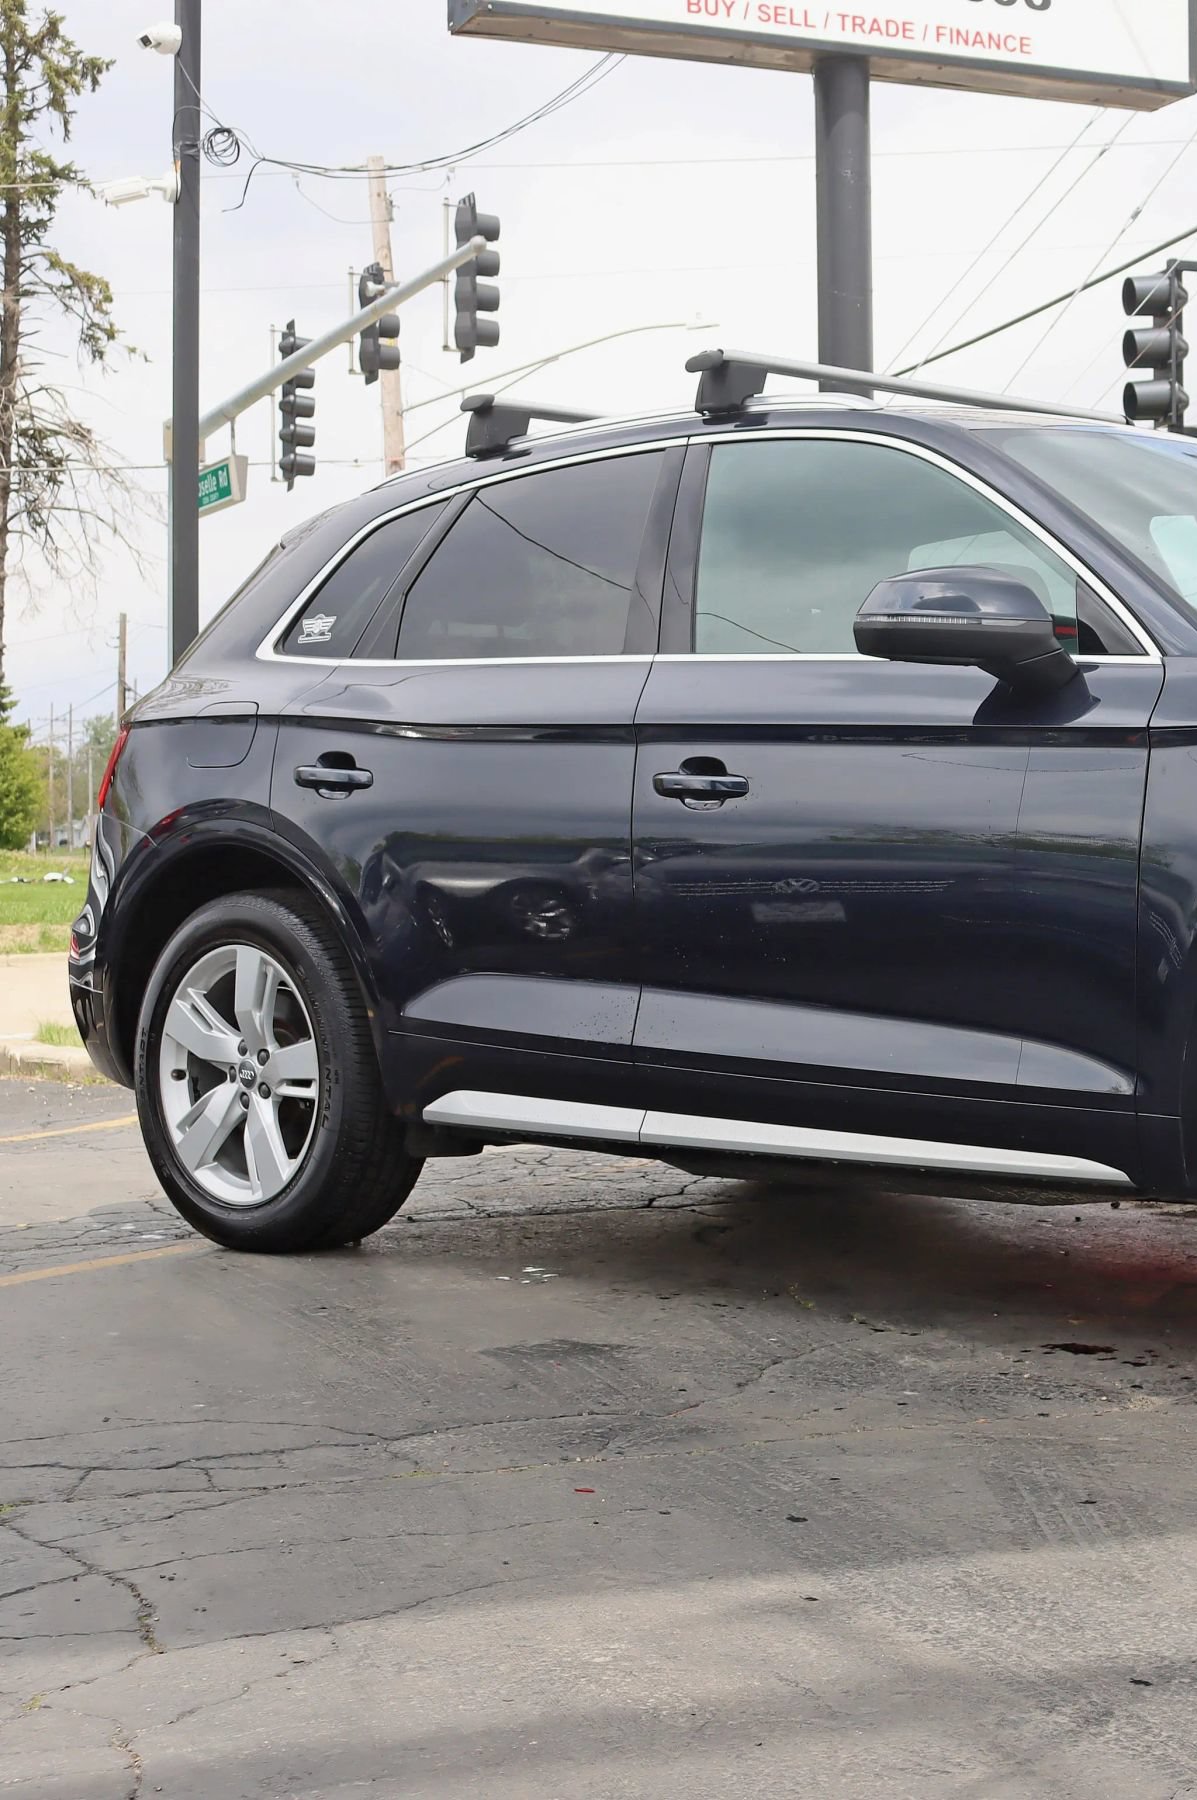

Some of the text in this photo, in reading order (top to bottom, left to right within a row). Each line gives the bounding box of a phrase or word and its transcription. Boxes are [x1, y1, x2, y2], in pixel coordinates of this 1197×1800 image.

[687, 0, 735, 18] BUY
[757, 4, 816, 28] SELL
[837, 13, 915, 40] TRADE
[936, 25, 1032, 55] FINANCE
[218, 466, 229, 488] Rd
